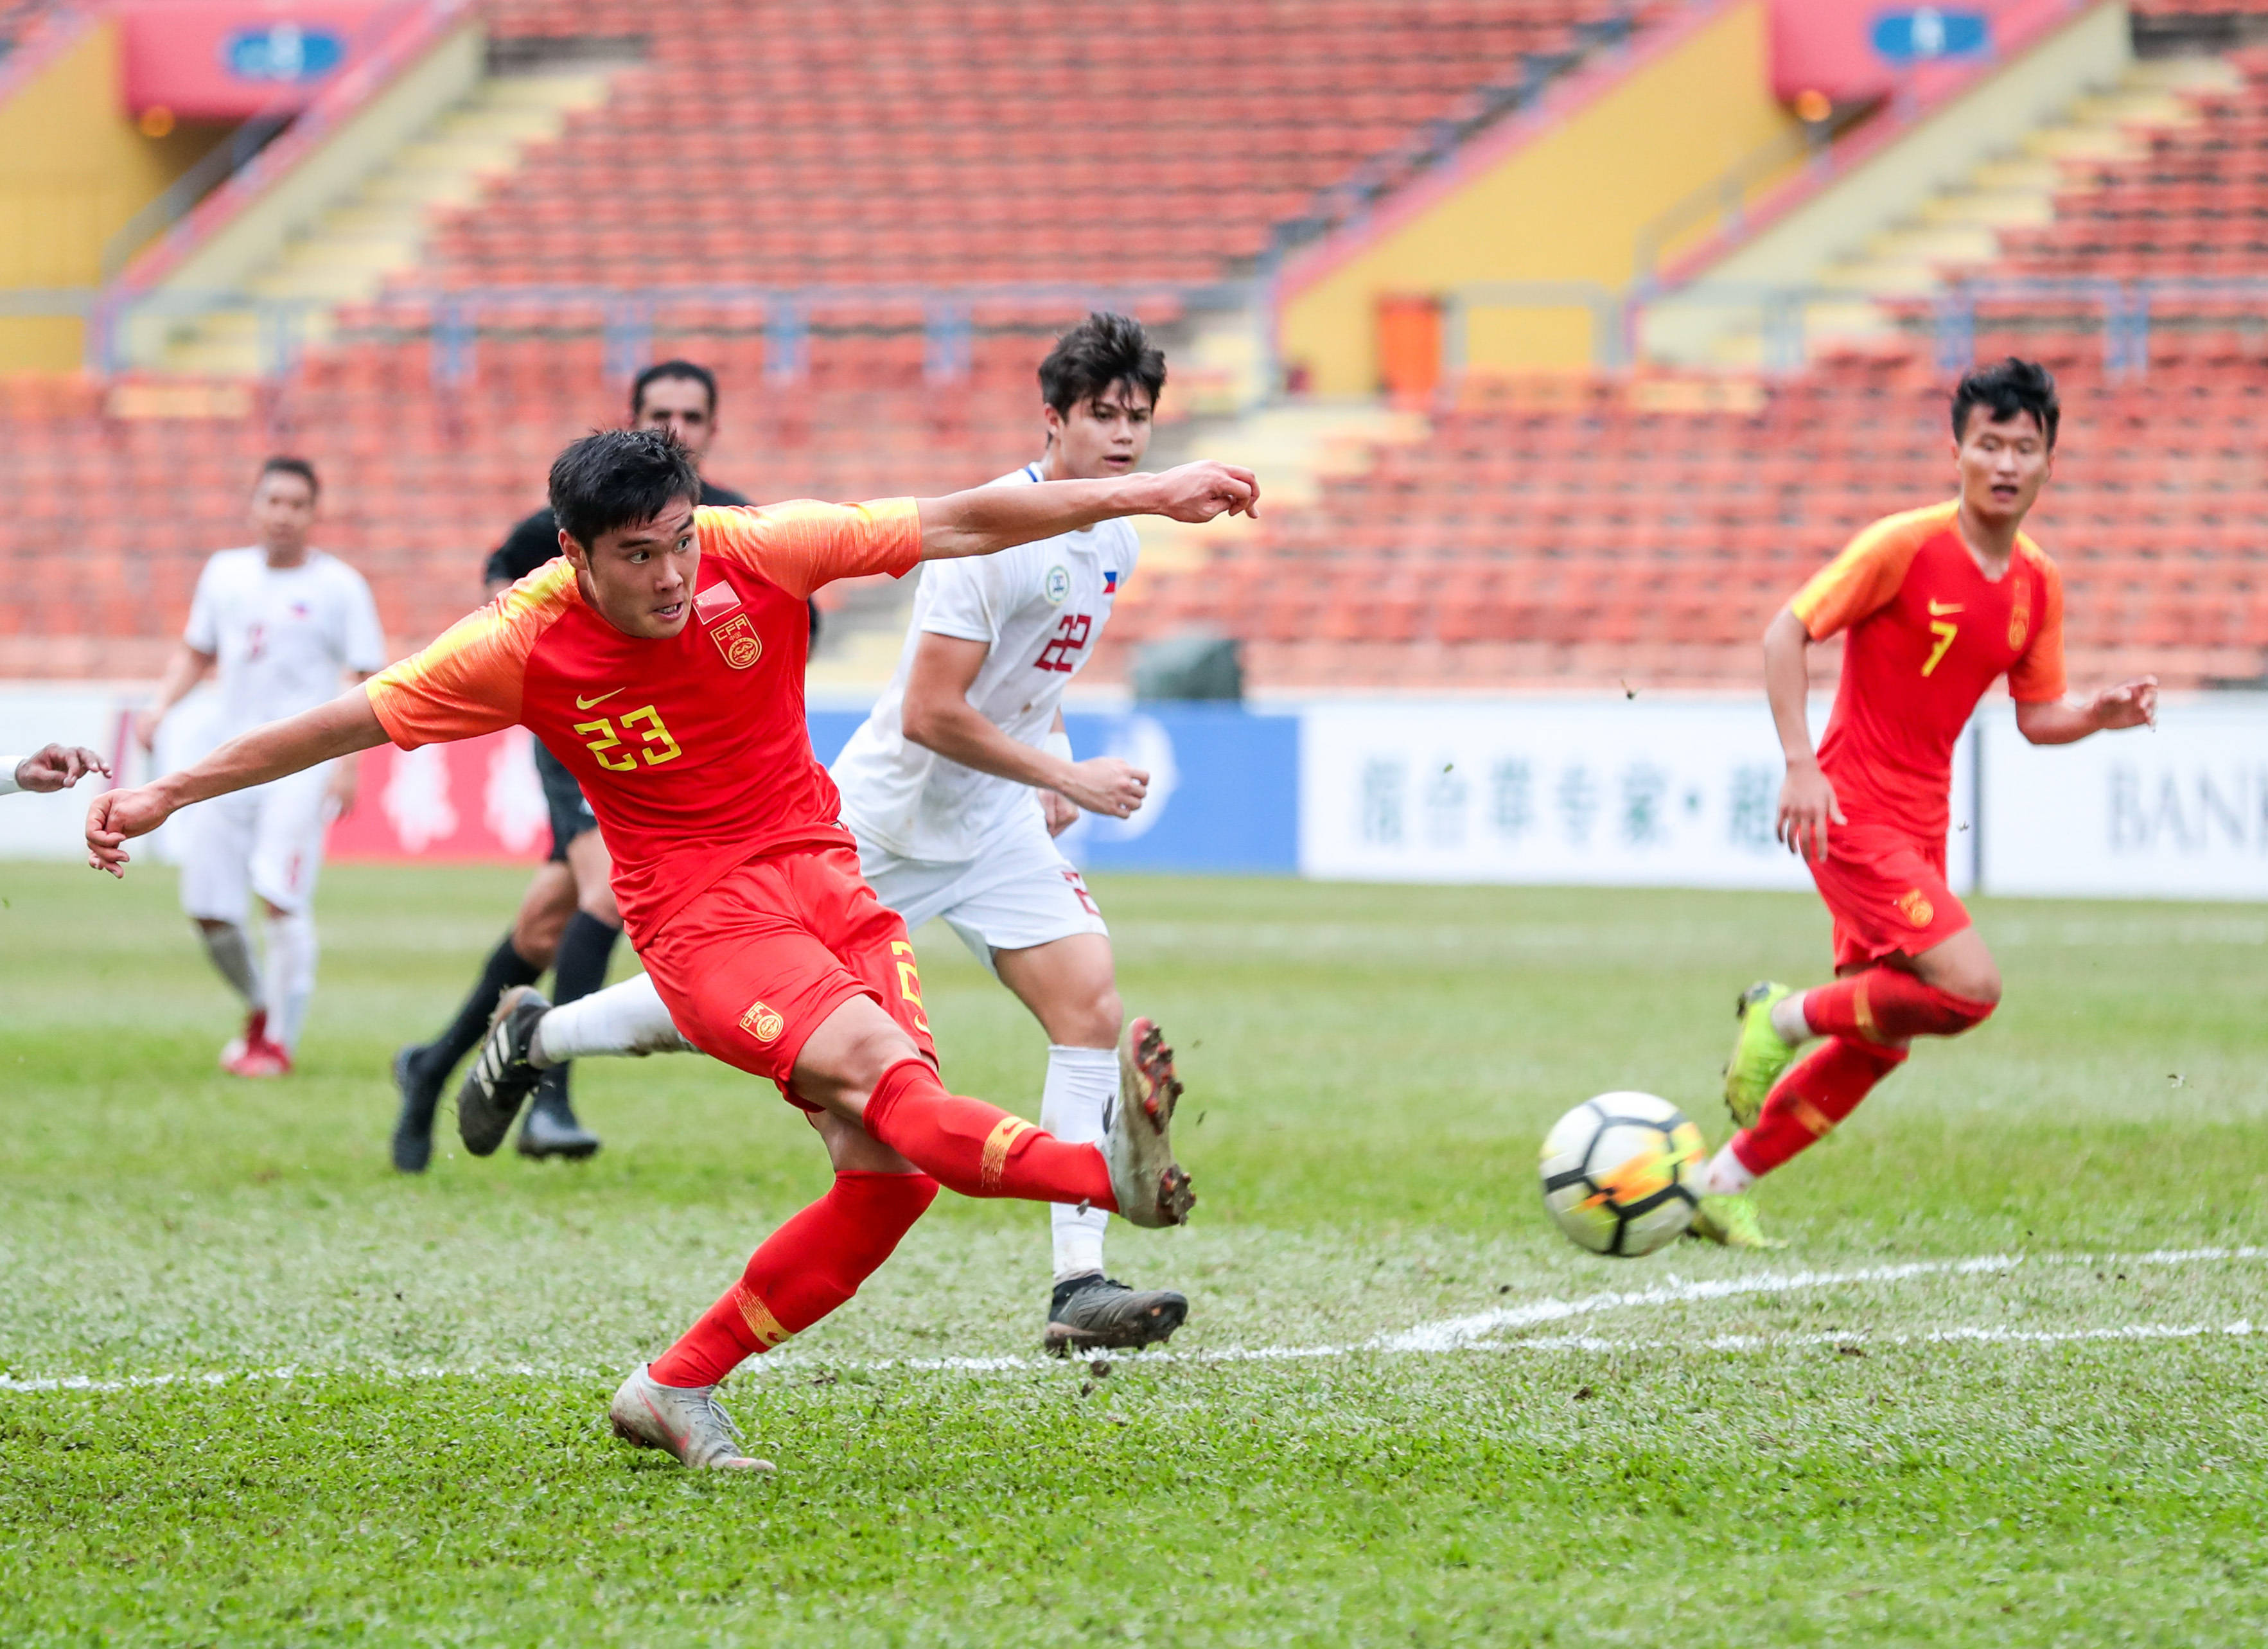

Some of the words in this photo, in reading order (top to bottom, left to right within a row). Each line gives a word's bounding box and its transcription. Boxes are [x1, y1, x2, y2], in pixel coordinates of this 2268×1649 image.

[715, 617, 747, 641] CFA
[1033, 614, 1092, 673] 22
[1921, 620, 1958, 676] 7
[574, 705, 682, 771] 23
[2105, 763, 2268, 853] BAN
[743, 1005, 764, 1028] CFA
